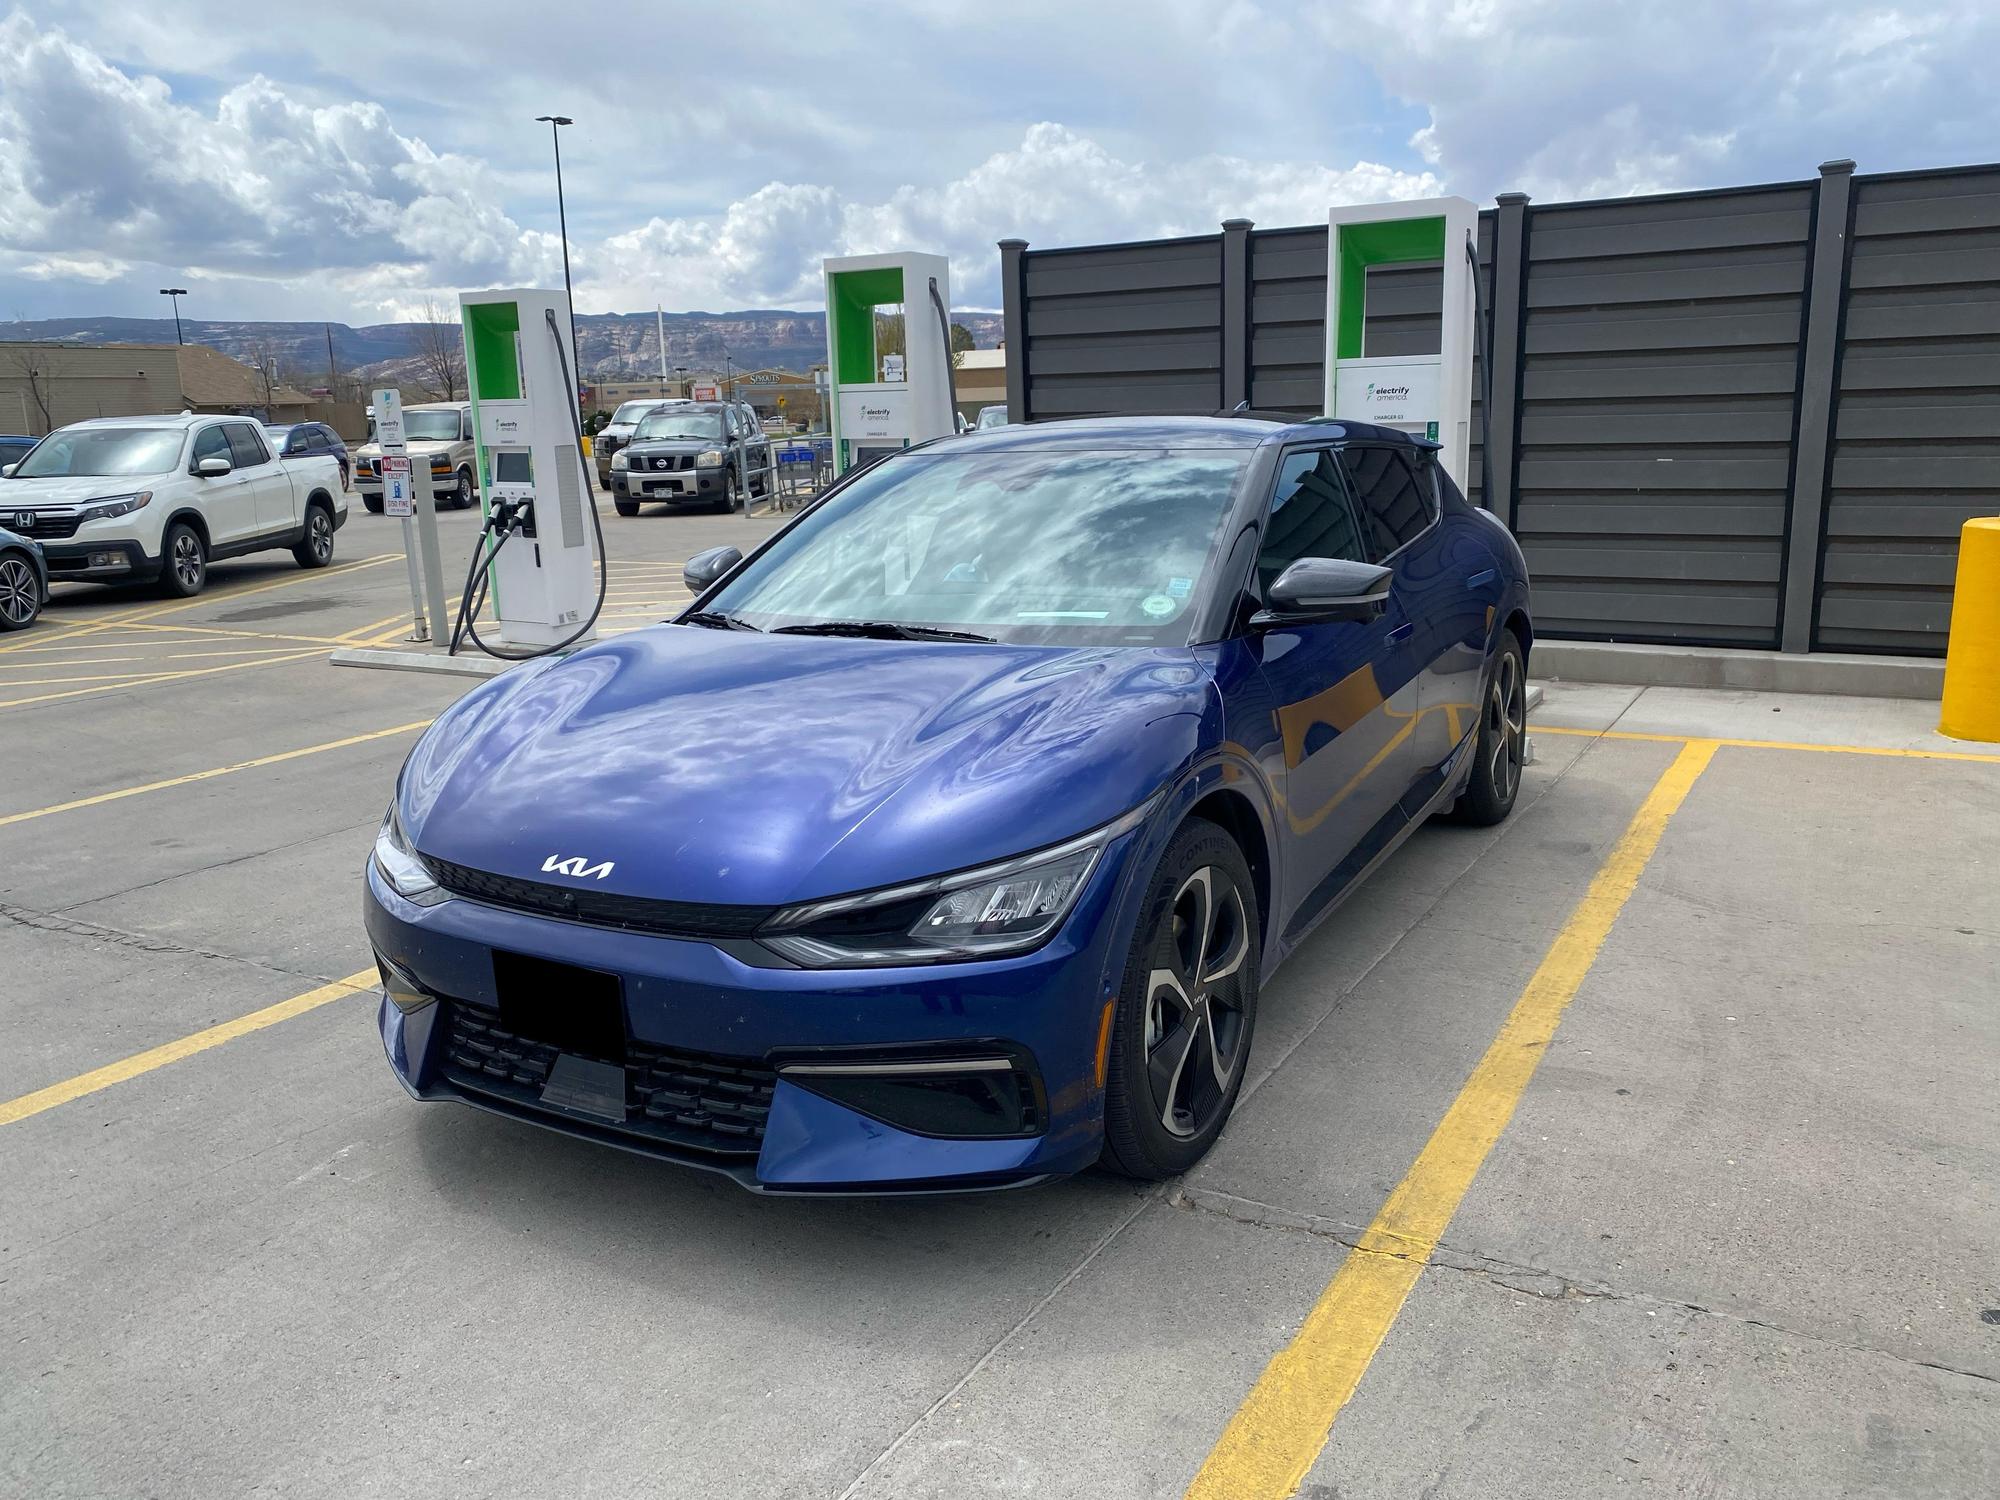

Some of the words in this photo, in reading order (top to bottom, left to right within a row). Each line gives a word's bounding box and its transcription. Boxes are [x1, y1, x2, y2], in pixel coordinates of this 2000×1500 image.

[750, 374, 780, 385] SPROUTS
[1376, 386, 1410, 395] electrify
[867, 408, 890, 416] electrify
[391, 459, 408, 468] PARKING
[388, 472, 404, 480] EXCEPT
[398, 500, 409, 508] FINE
[541, 854, 615, 880] KIA
